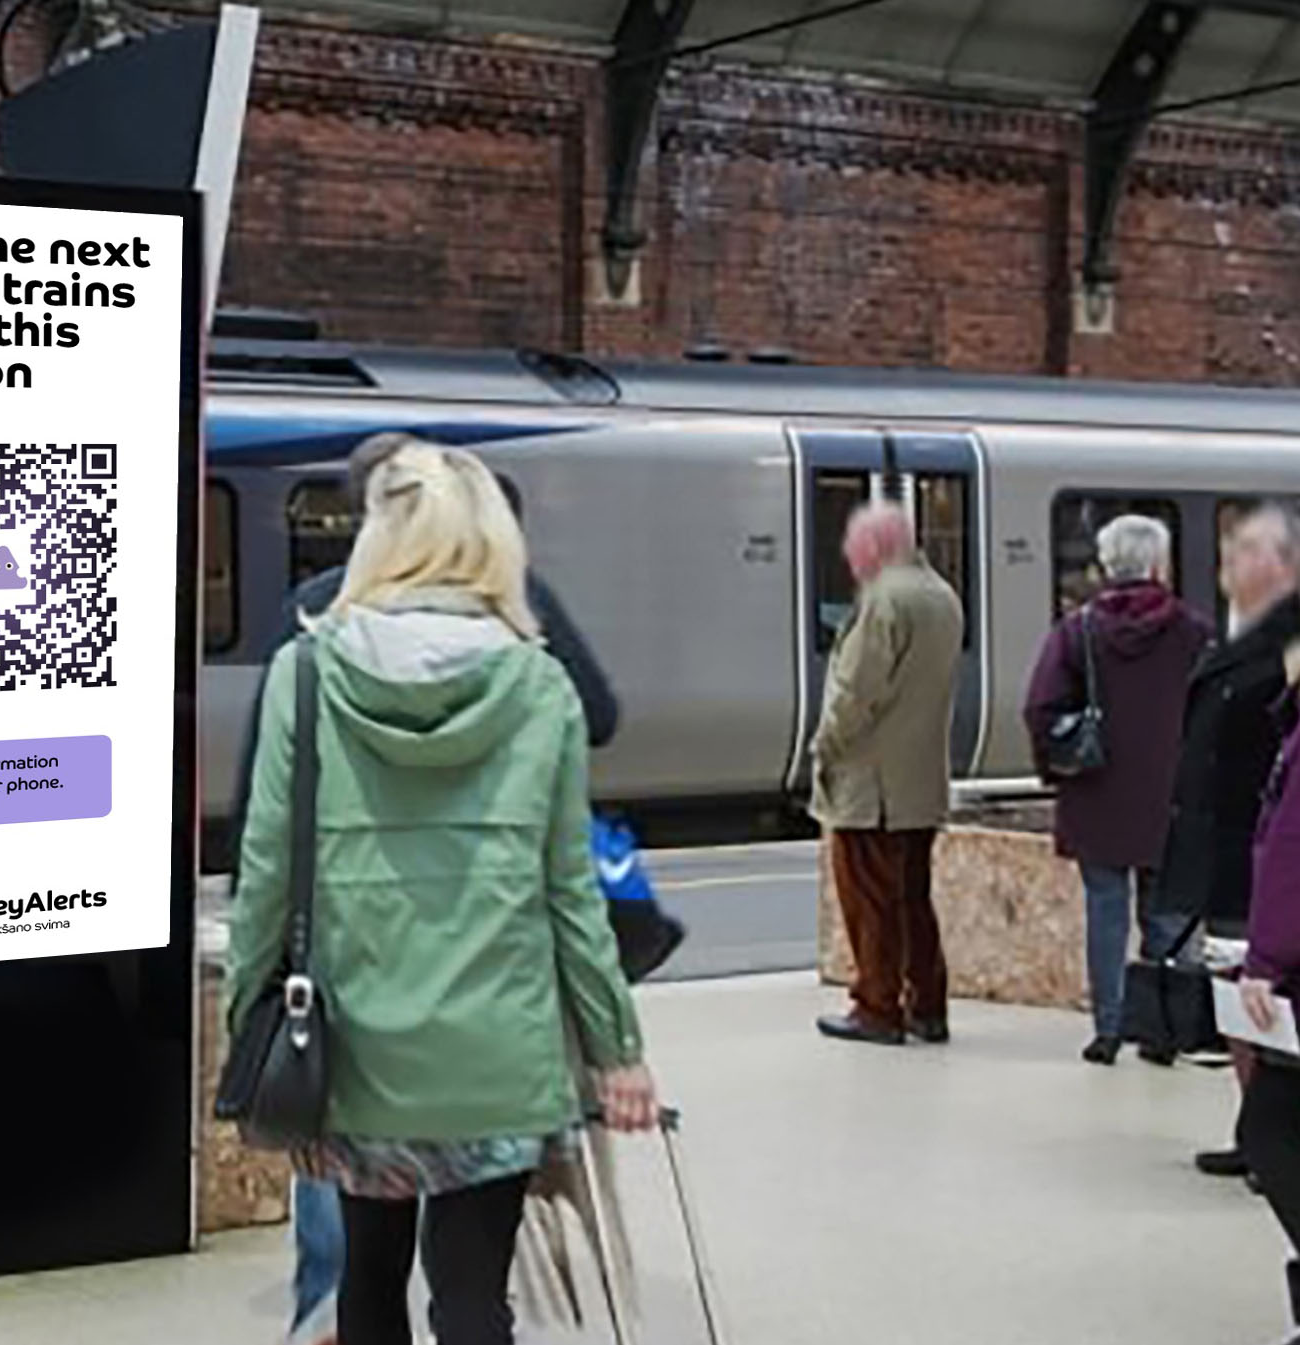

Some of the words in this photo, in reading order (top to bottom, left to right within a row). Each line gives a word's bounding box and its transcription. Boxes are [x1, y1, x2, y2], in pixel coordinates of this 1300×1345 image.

[50, 236, 151, 268] next
[3, 271, 136, 309] trains
[6, 776, 64, 795] phone.
[34, 919, 71, 931] svima
